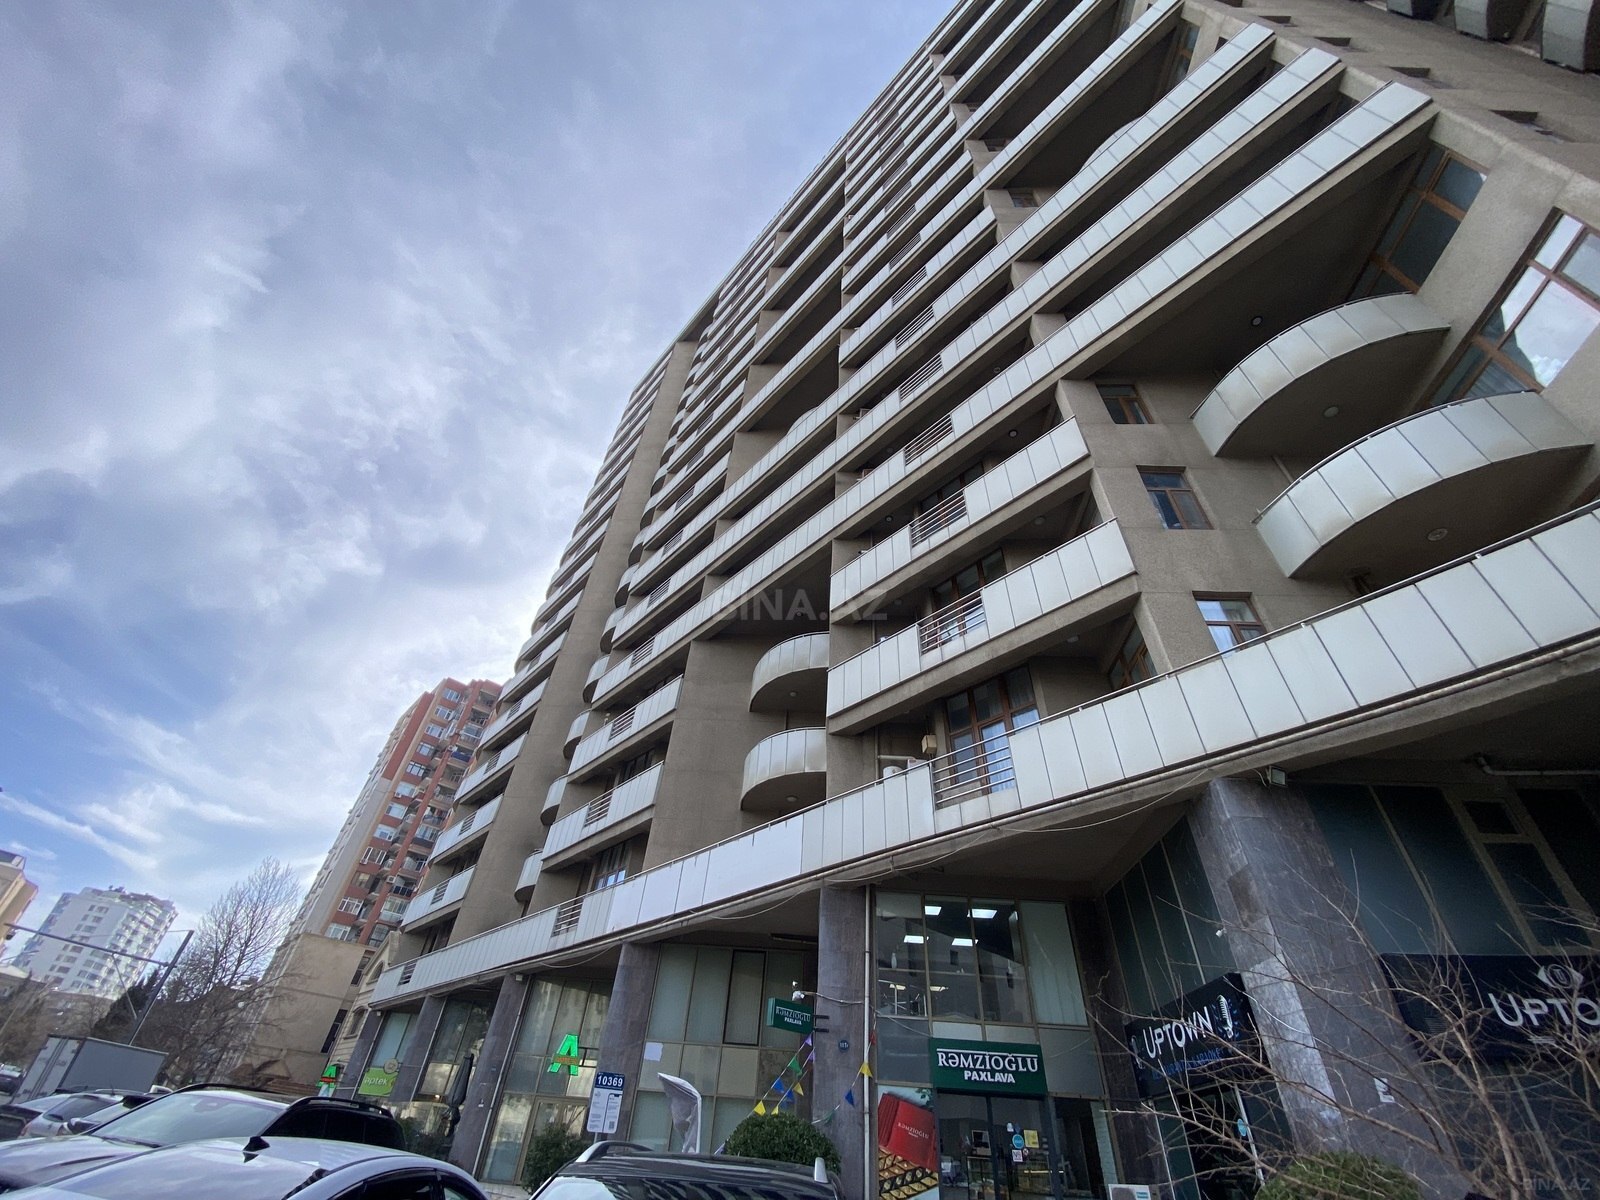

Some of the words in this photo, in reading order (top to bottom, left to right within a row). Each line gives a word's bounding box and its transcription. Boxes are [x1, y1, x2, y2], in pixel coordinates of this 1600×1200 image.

[1142, 1006, 1214, 1059] UPTOWN
[937, 1051, 1038, 1072] RƏMZİOĞLU
[597, 1075, 623, 1087] 10369
[964, 1070, 1016, 1083] PAXLAVA
